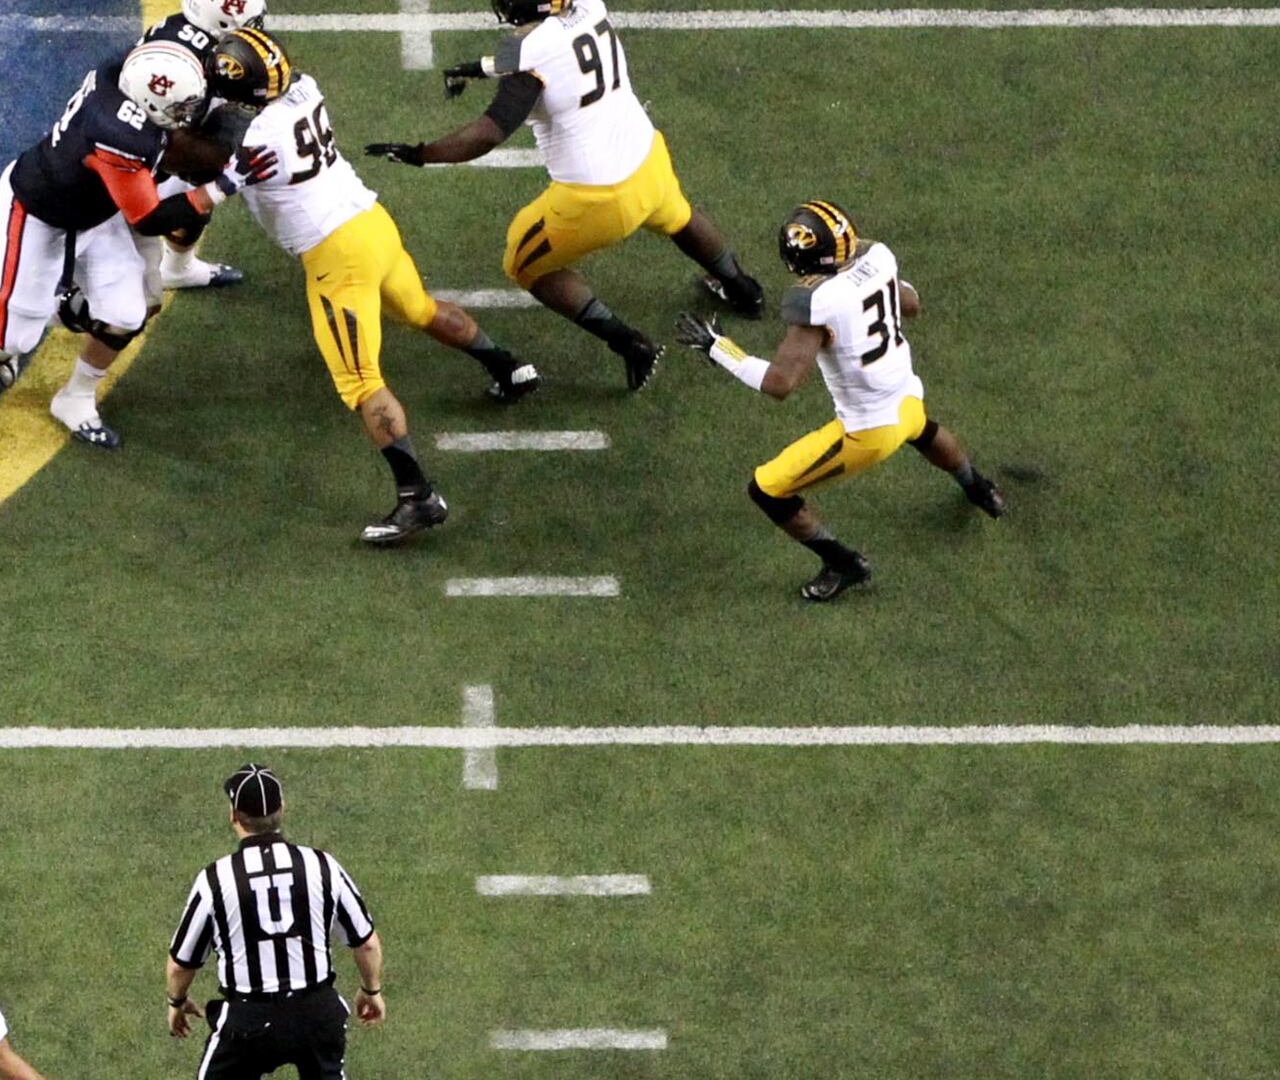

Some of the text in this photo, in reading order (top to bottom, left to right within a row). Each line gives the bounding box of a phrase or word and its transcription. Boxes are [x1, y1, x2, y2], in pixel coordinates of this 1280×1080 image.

[177, 24, 210, 50] 50
[572, 19, 620, 108] 97
[116, 100, 148, 131] 62
[860, 278, 903, 367] 31
[249, 872, 294, 935] U
